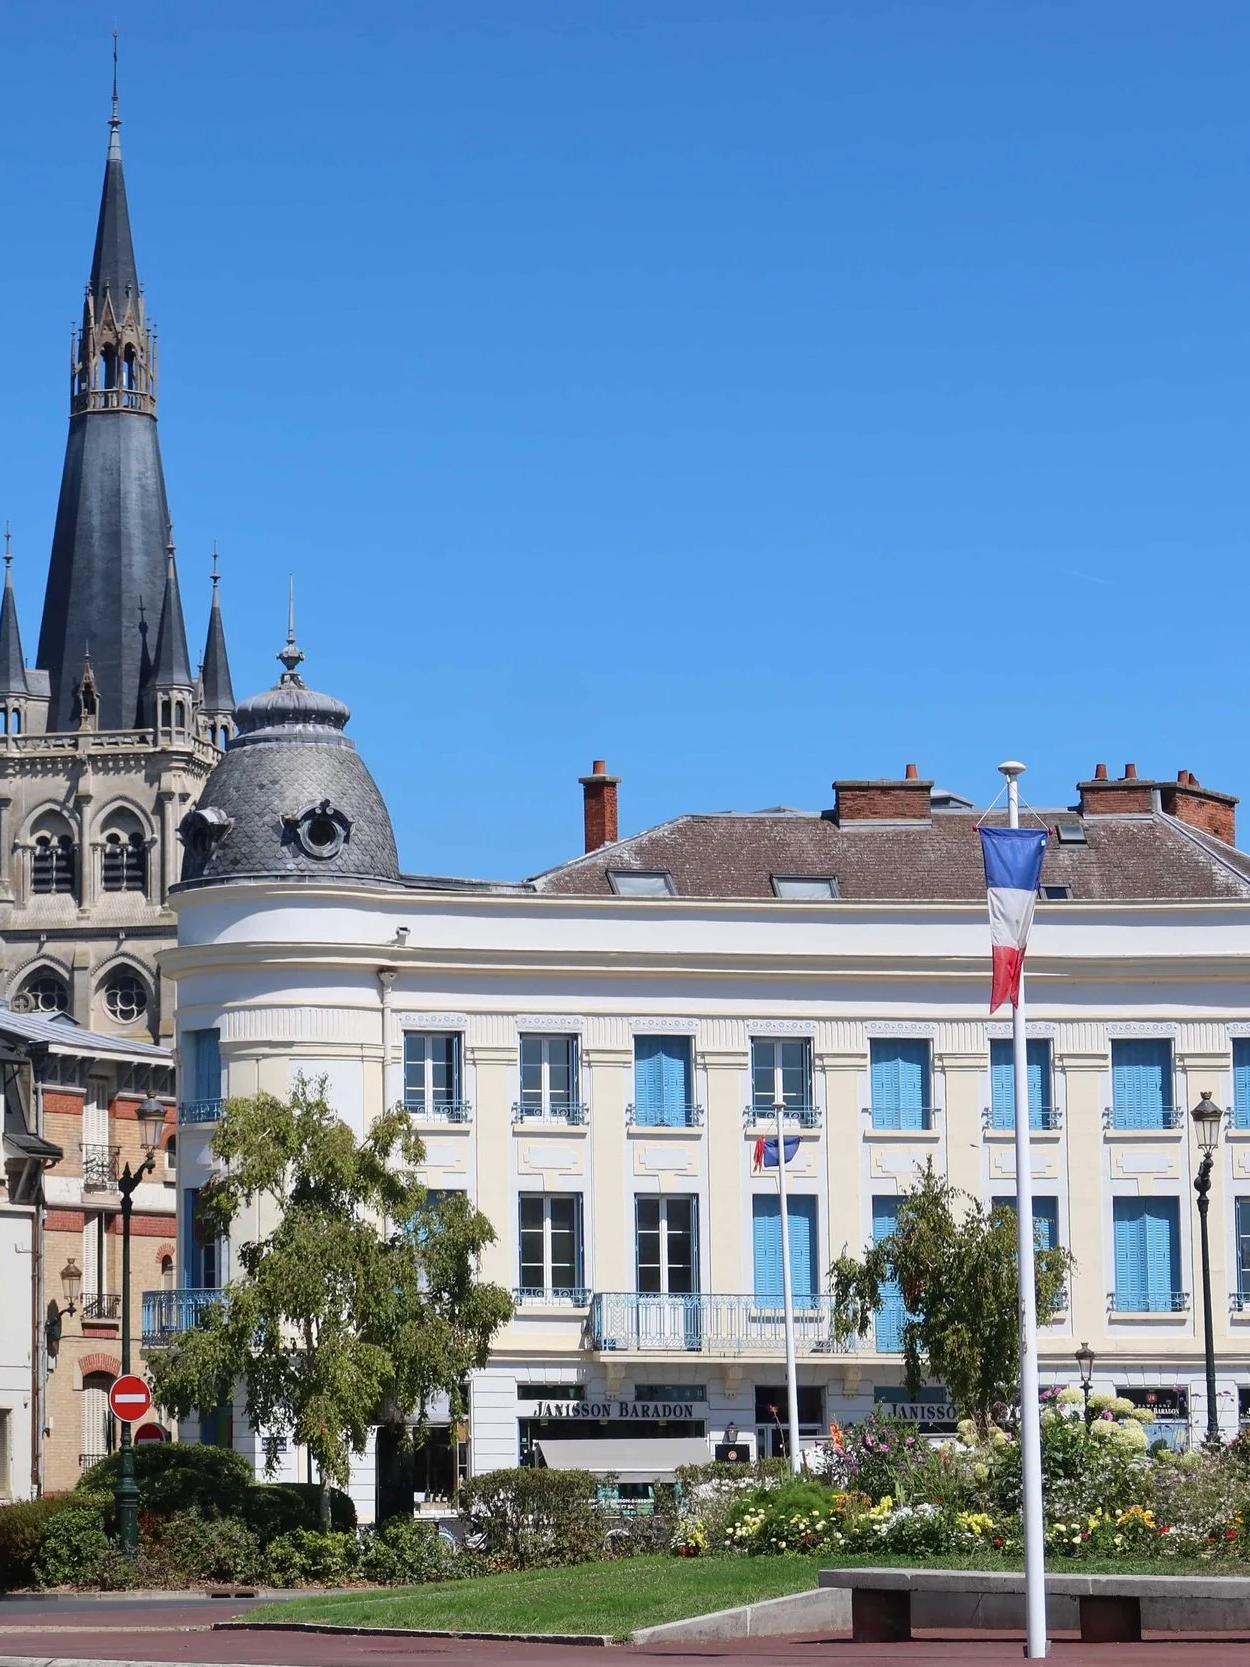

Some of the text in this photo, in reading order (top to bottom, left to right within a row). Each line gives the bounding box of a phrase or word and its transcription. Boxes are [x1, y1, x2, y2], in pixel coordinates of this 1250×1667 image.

[534, 1401, 694, 1418] JANISSON BARADON
[889, 1403, 957, 1420] JANISSO
